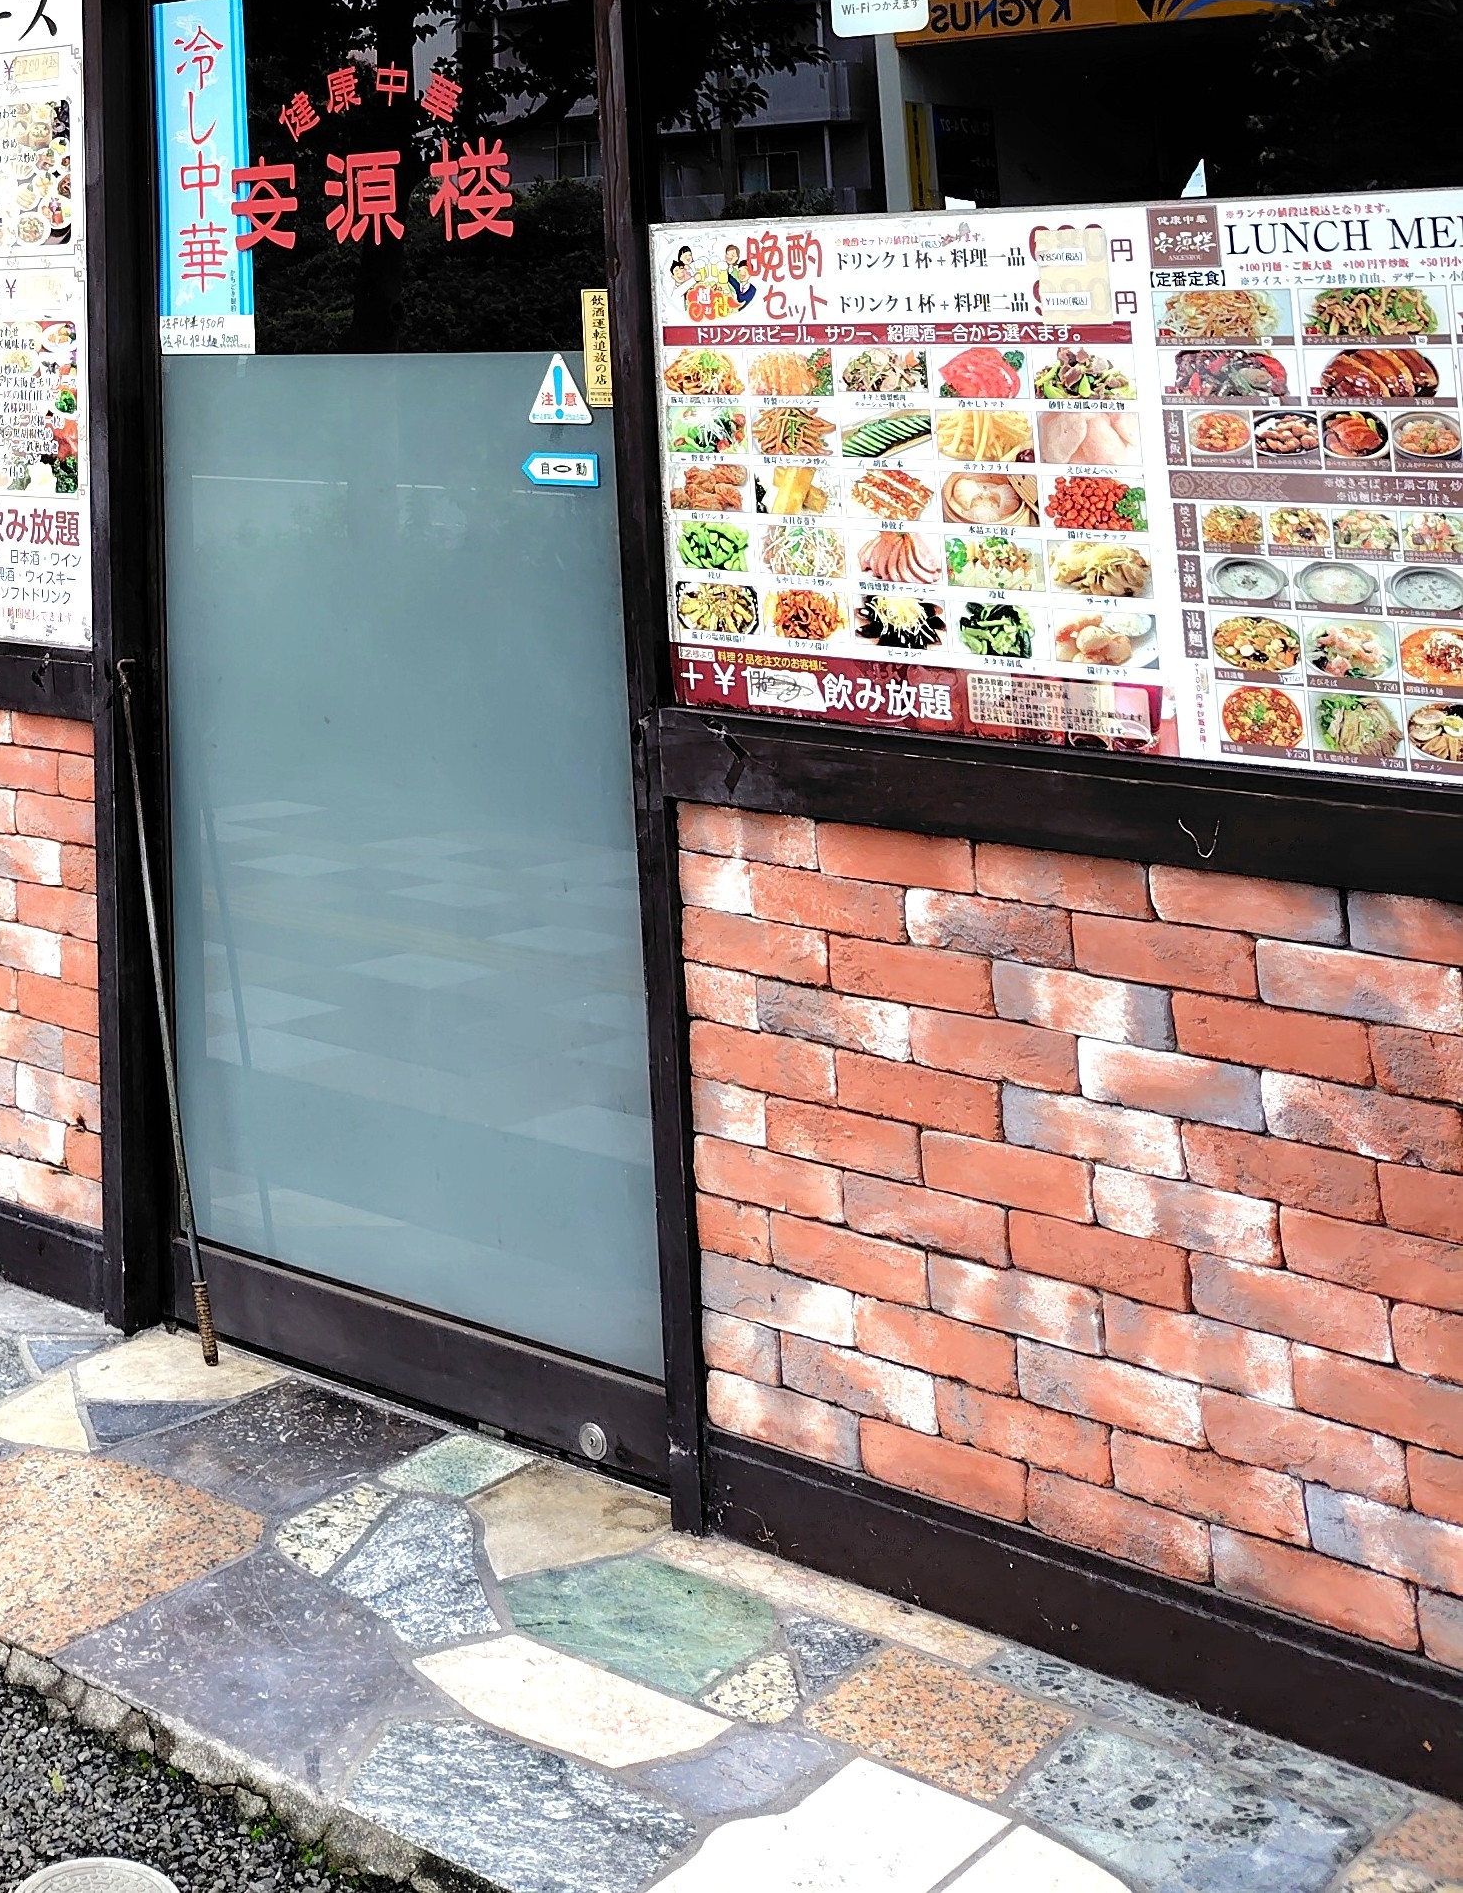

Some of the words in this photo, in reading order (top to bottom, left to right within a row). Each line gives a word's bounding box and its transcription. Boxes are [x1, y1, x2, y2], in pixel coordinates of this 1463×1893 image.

[278, 61, 463, 142] 健康中華
[173, 25, 228, 294] 冷し中華
[231, 136, 514, 251] 安源楼
[746, 230, 822, 283] 晩酌
[1111, 239, 1133, 262] 円
[1224, 219, 1373, 255] LUNCH
[1386, 215, 1463, 250] ME
[1115, 291, 1137, 315] 円
[1149, 270, 1226, 289] 【定番定食】
[763, 285, 828, 324] セット
[591, 294, 609, 386] 飲酒運転追放の店
[822, 672, 953, 721] 飲み放題
